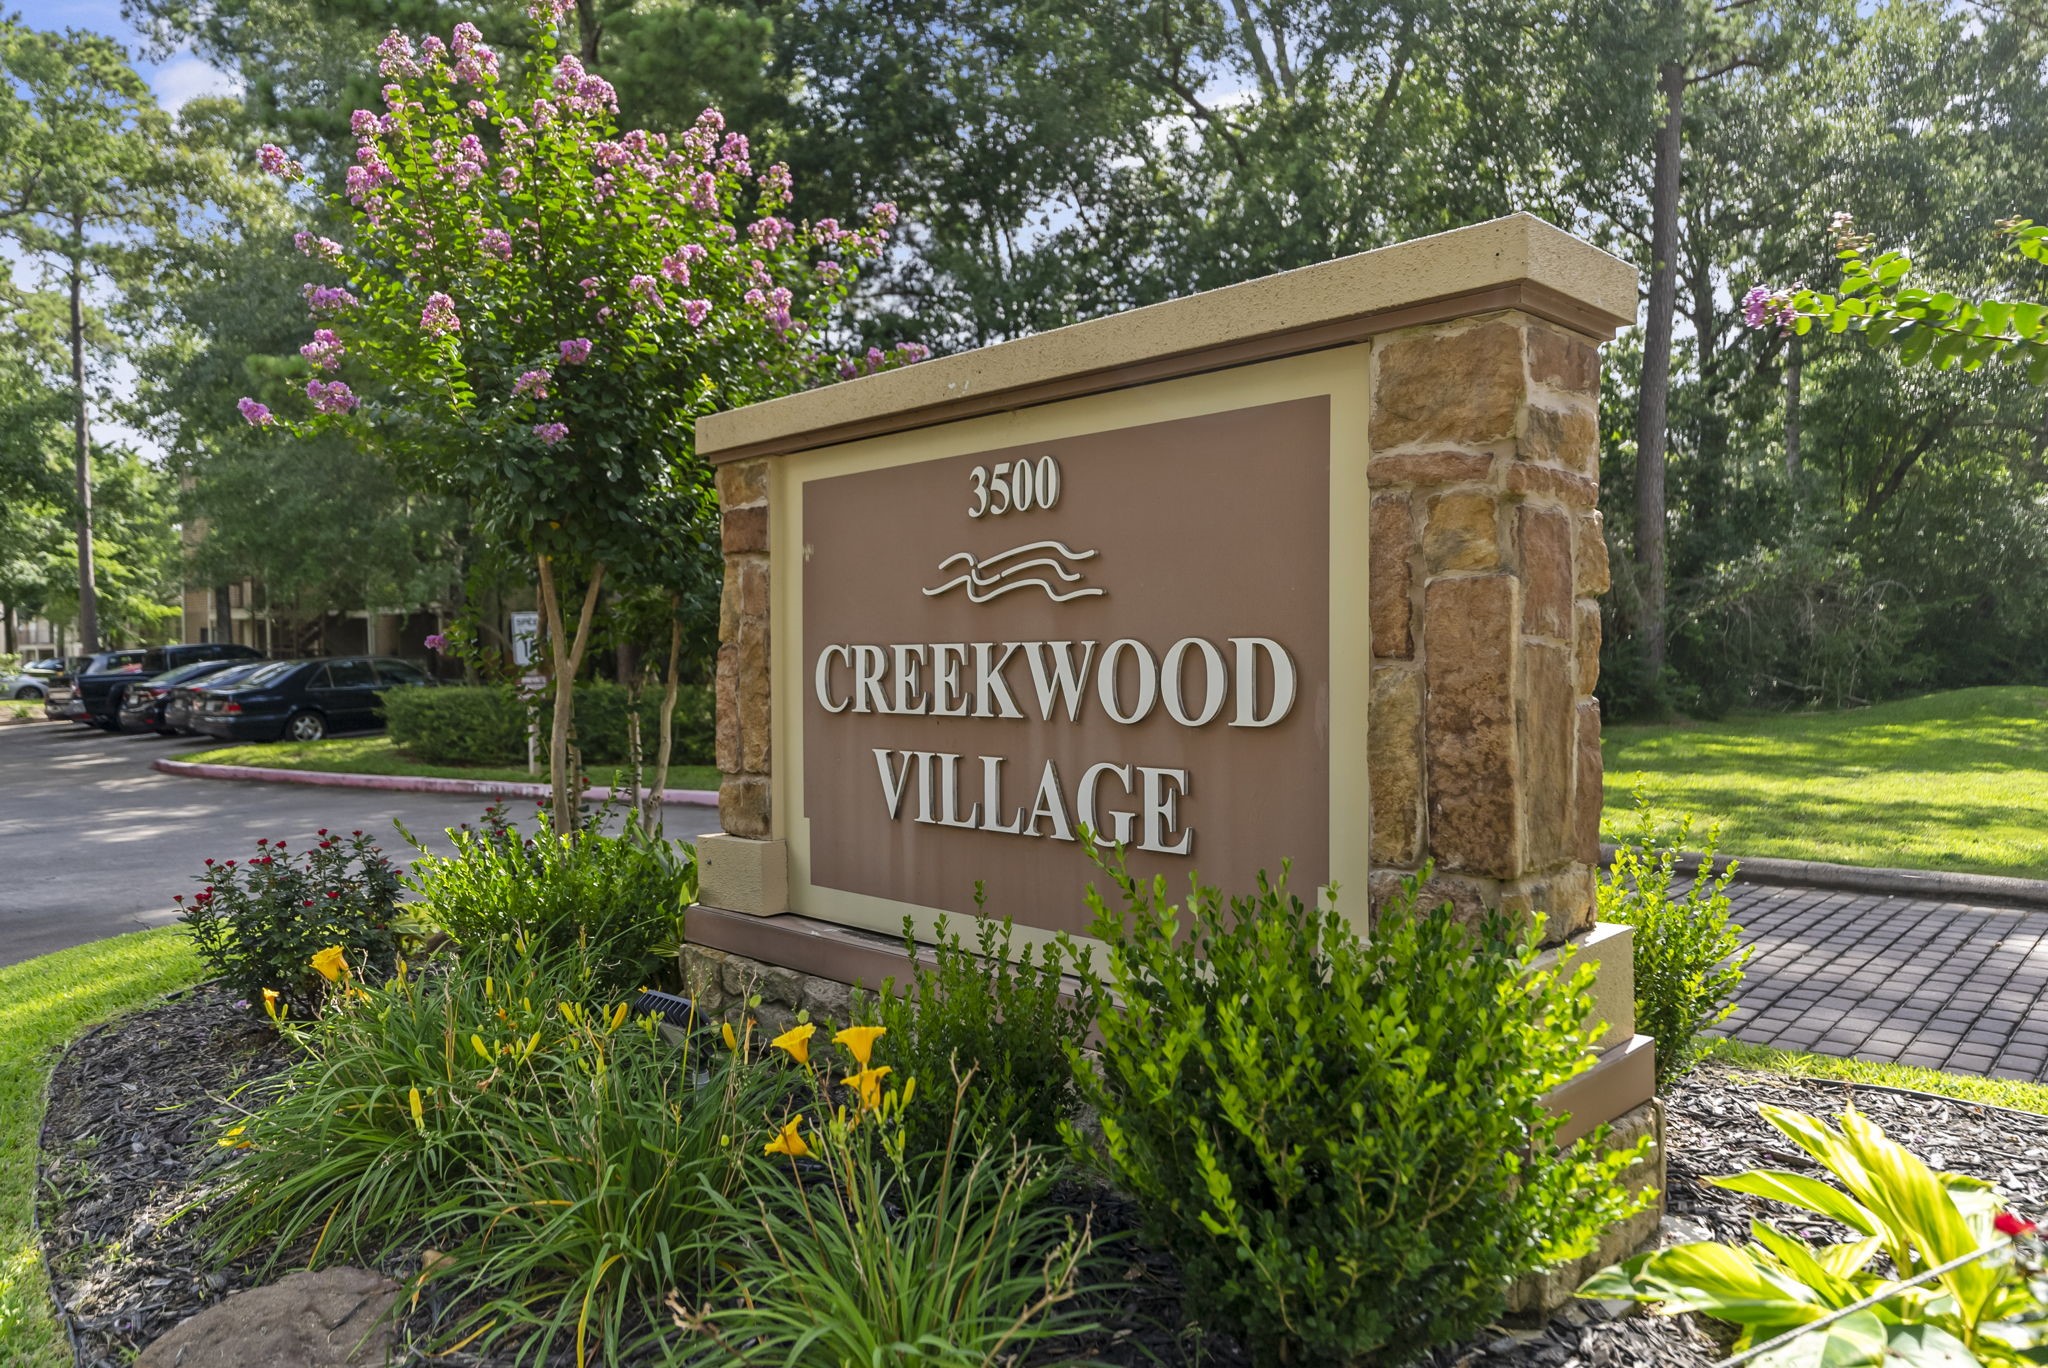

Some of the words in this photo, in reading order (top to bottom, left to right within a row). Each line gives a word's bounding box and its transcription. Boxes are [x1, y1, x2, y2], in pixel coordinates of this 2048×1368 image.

[968, 456, 1060, 518] 3500
[815, 637, 1297, 728] CREEKWOOD
[872, 748, 1193, 856] VILLAGE
